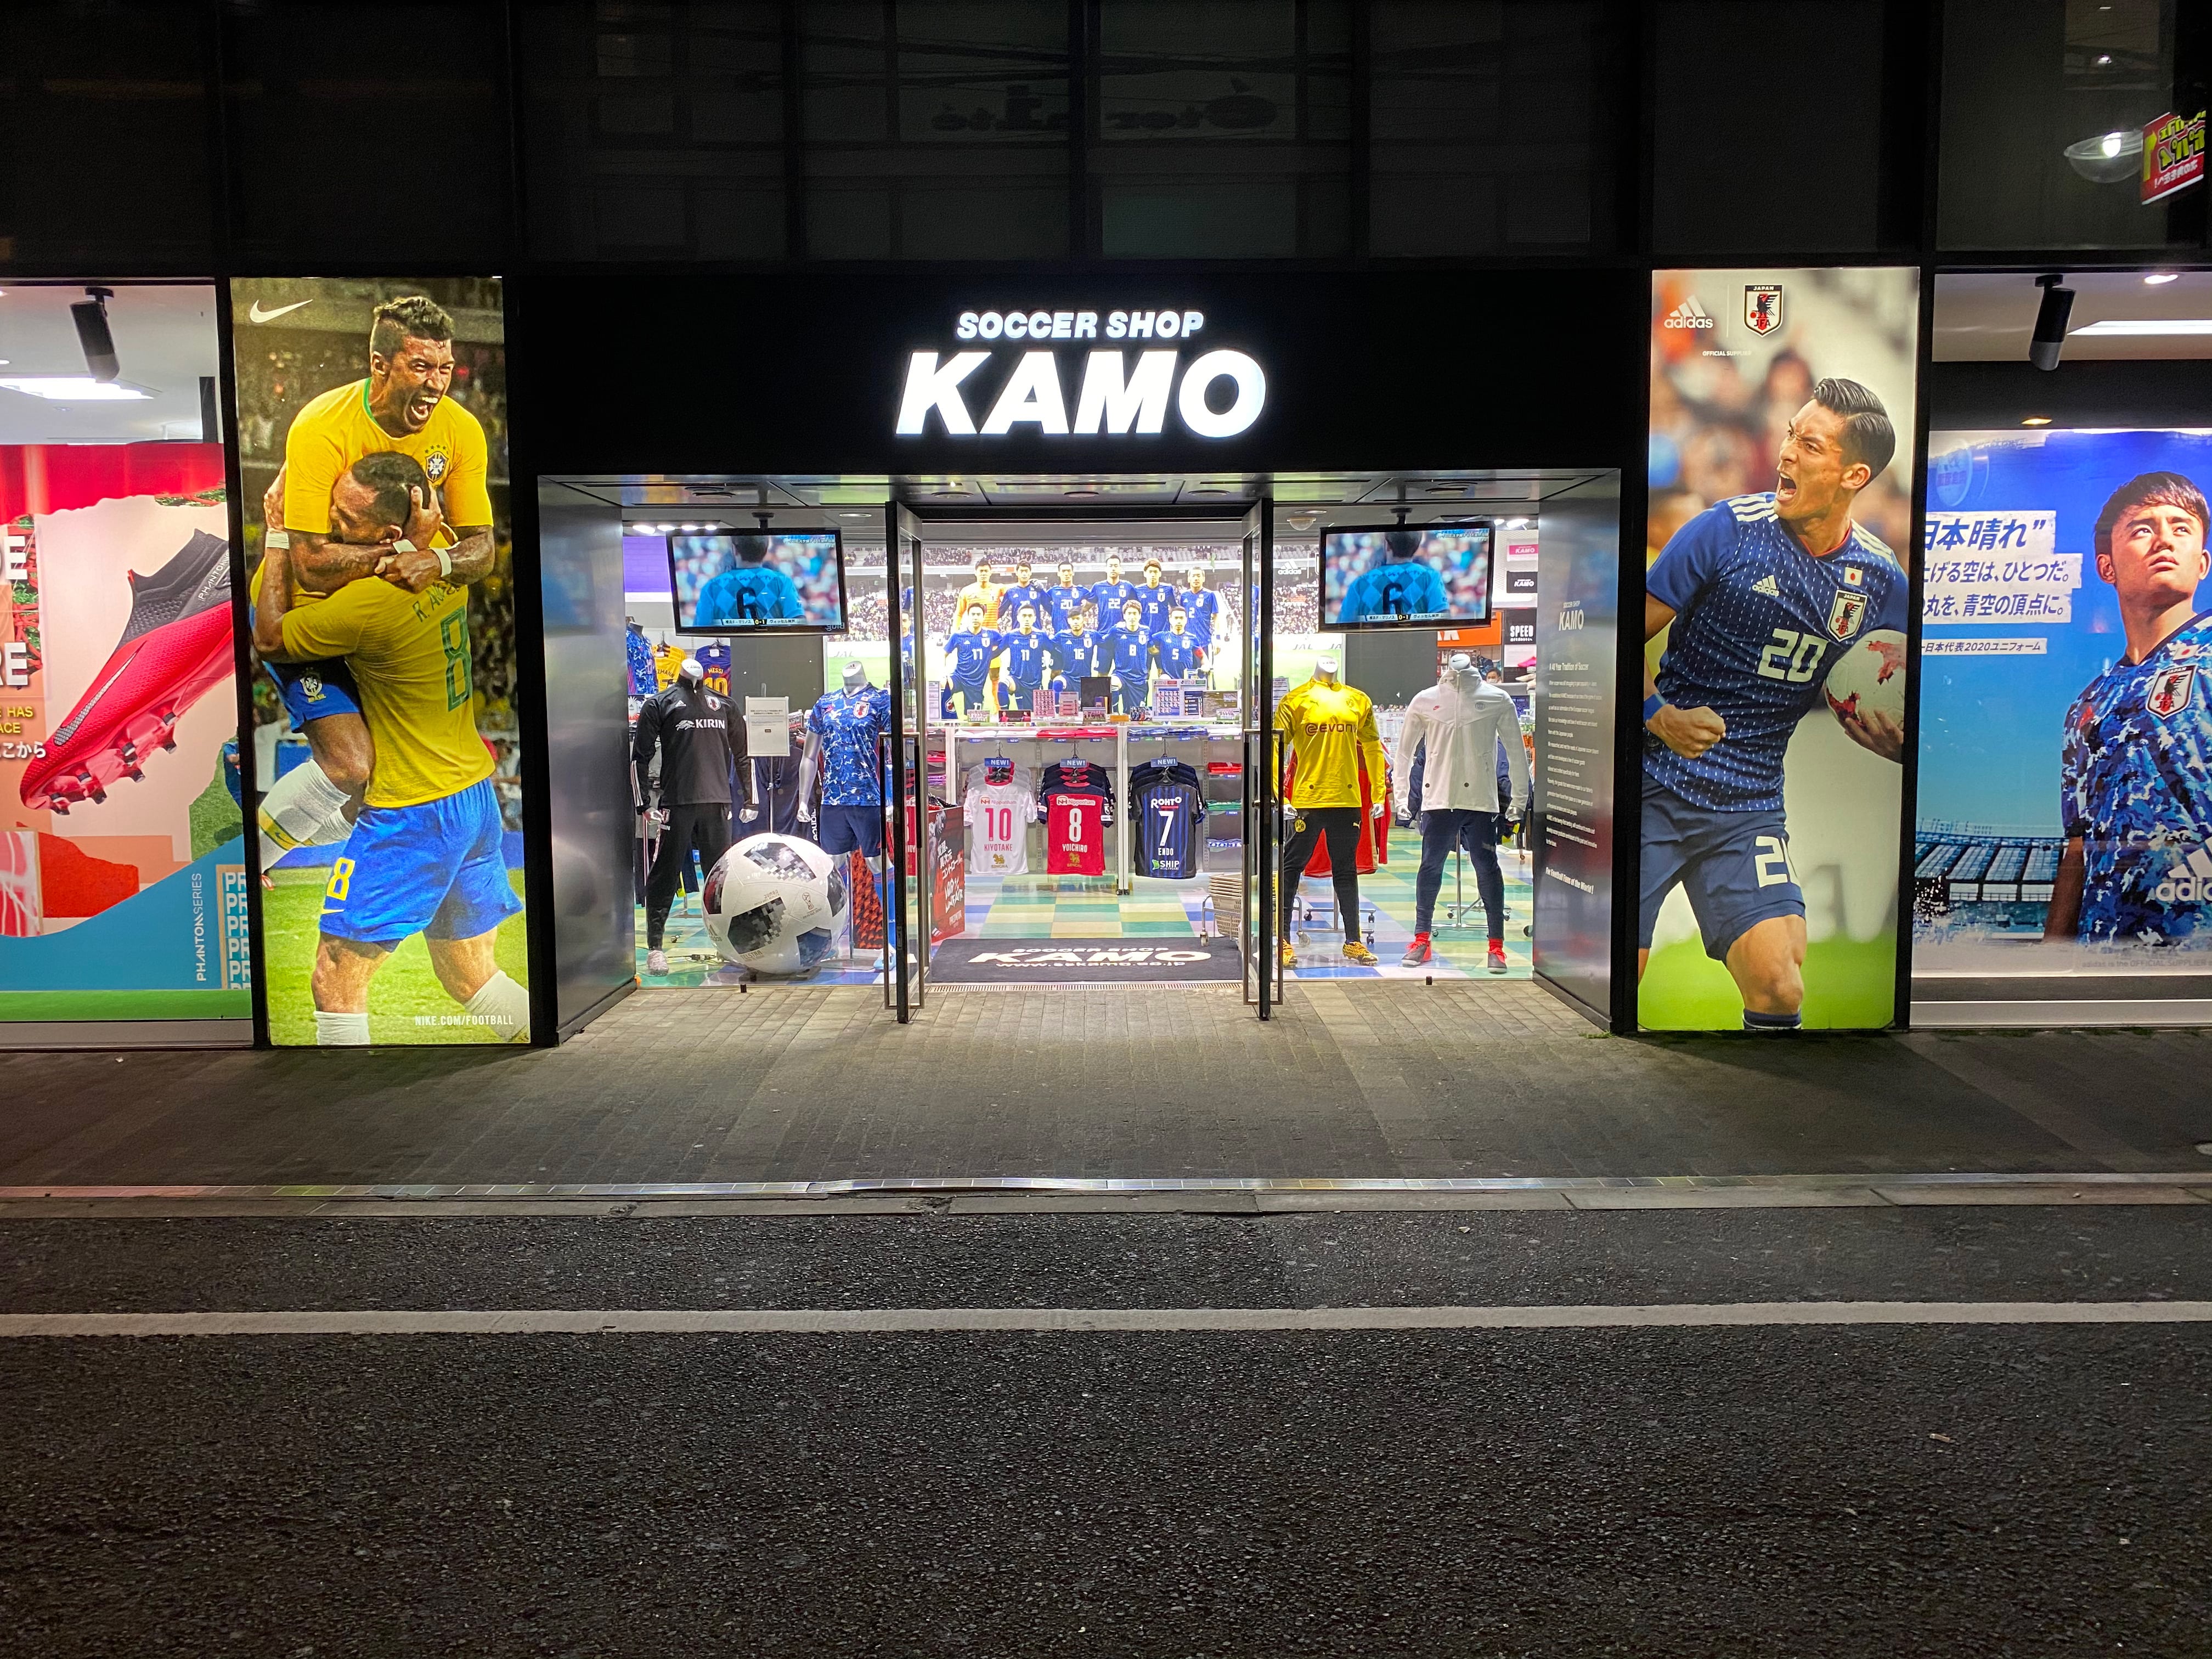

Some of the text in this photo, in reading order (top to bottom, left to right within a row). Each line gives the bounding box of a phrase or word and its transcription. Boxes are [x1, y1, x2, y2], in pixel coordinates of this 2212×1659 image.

[956, 311, 1204, 338] SOCCER SHOP
[1664, 316, 1713, 329] adidas
[895, 349, 1266, 438] KAMO
[0, 536, 27, 579] E
[1752, 584, 1780, 597] adidas
[1061, 599, 1073, 610] 20
[1108, 598, 1120, 609] 22
[1148, 602, 1158, 613] 15
[1922, 593, 2063, 617] 丸を、青空の頂点に。
[1189, 607, 1195, 618] 2
[1559, 610, 1585, 631] KAMO
[1510, 625, 1534, 637] SPEED
[1020, 650, 1030, 661] 11
[1073, 648, 1085, 660] 16
[1129, 645, 1137, 656] 8
[1172, 648, 1180, 660] 5
[1757, 628, 1830, 682] 20
[440, 606, 473, 712] 8
[1578, 663, 1589, 671] Soccer
[2166, 666, 2187, 675] JAPAN
[2156, 699, 2175, 710] JFA
[7, 706, 33, 718] HAS
[695, 719, 725, 729] KIRIN
[1319, 724, 1357, 733] EVONI
[985, 808, 1012, 842] 10
[1069, 808, 1082, 842] 8
[1158, 810, 1174, 847] 7
[1062, 843, 1088, 853] YOICHIRO
[1158, 848, 1174, 856] ENDO
[327, 857, 356, 901] 8
[740, 950, 763, 960] TELSTRA
[968, 951, 1212, 963] KAMO
[415, 1015, 514, 1026] NIKE.COM/FOOTBALL
